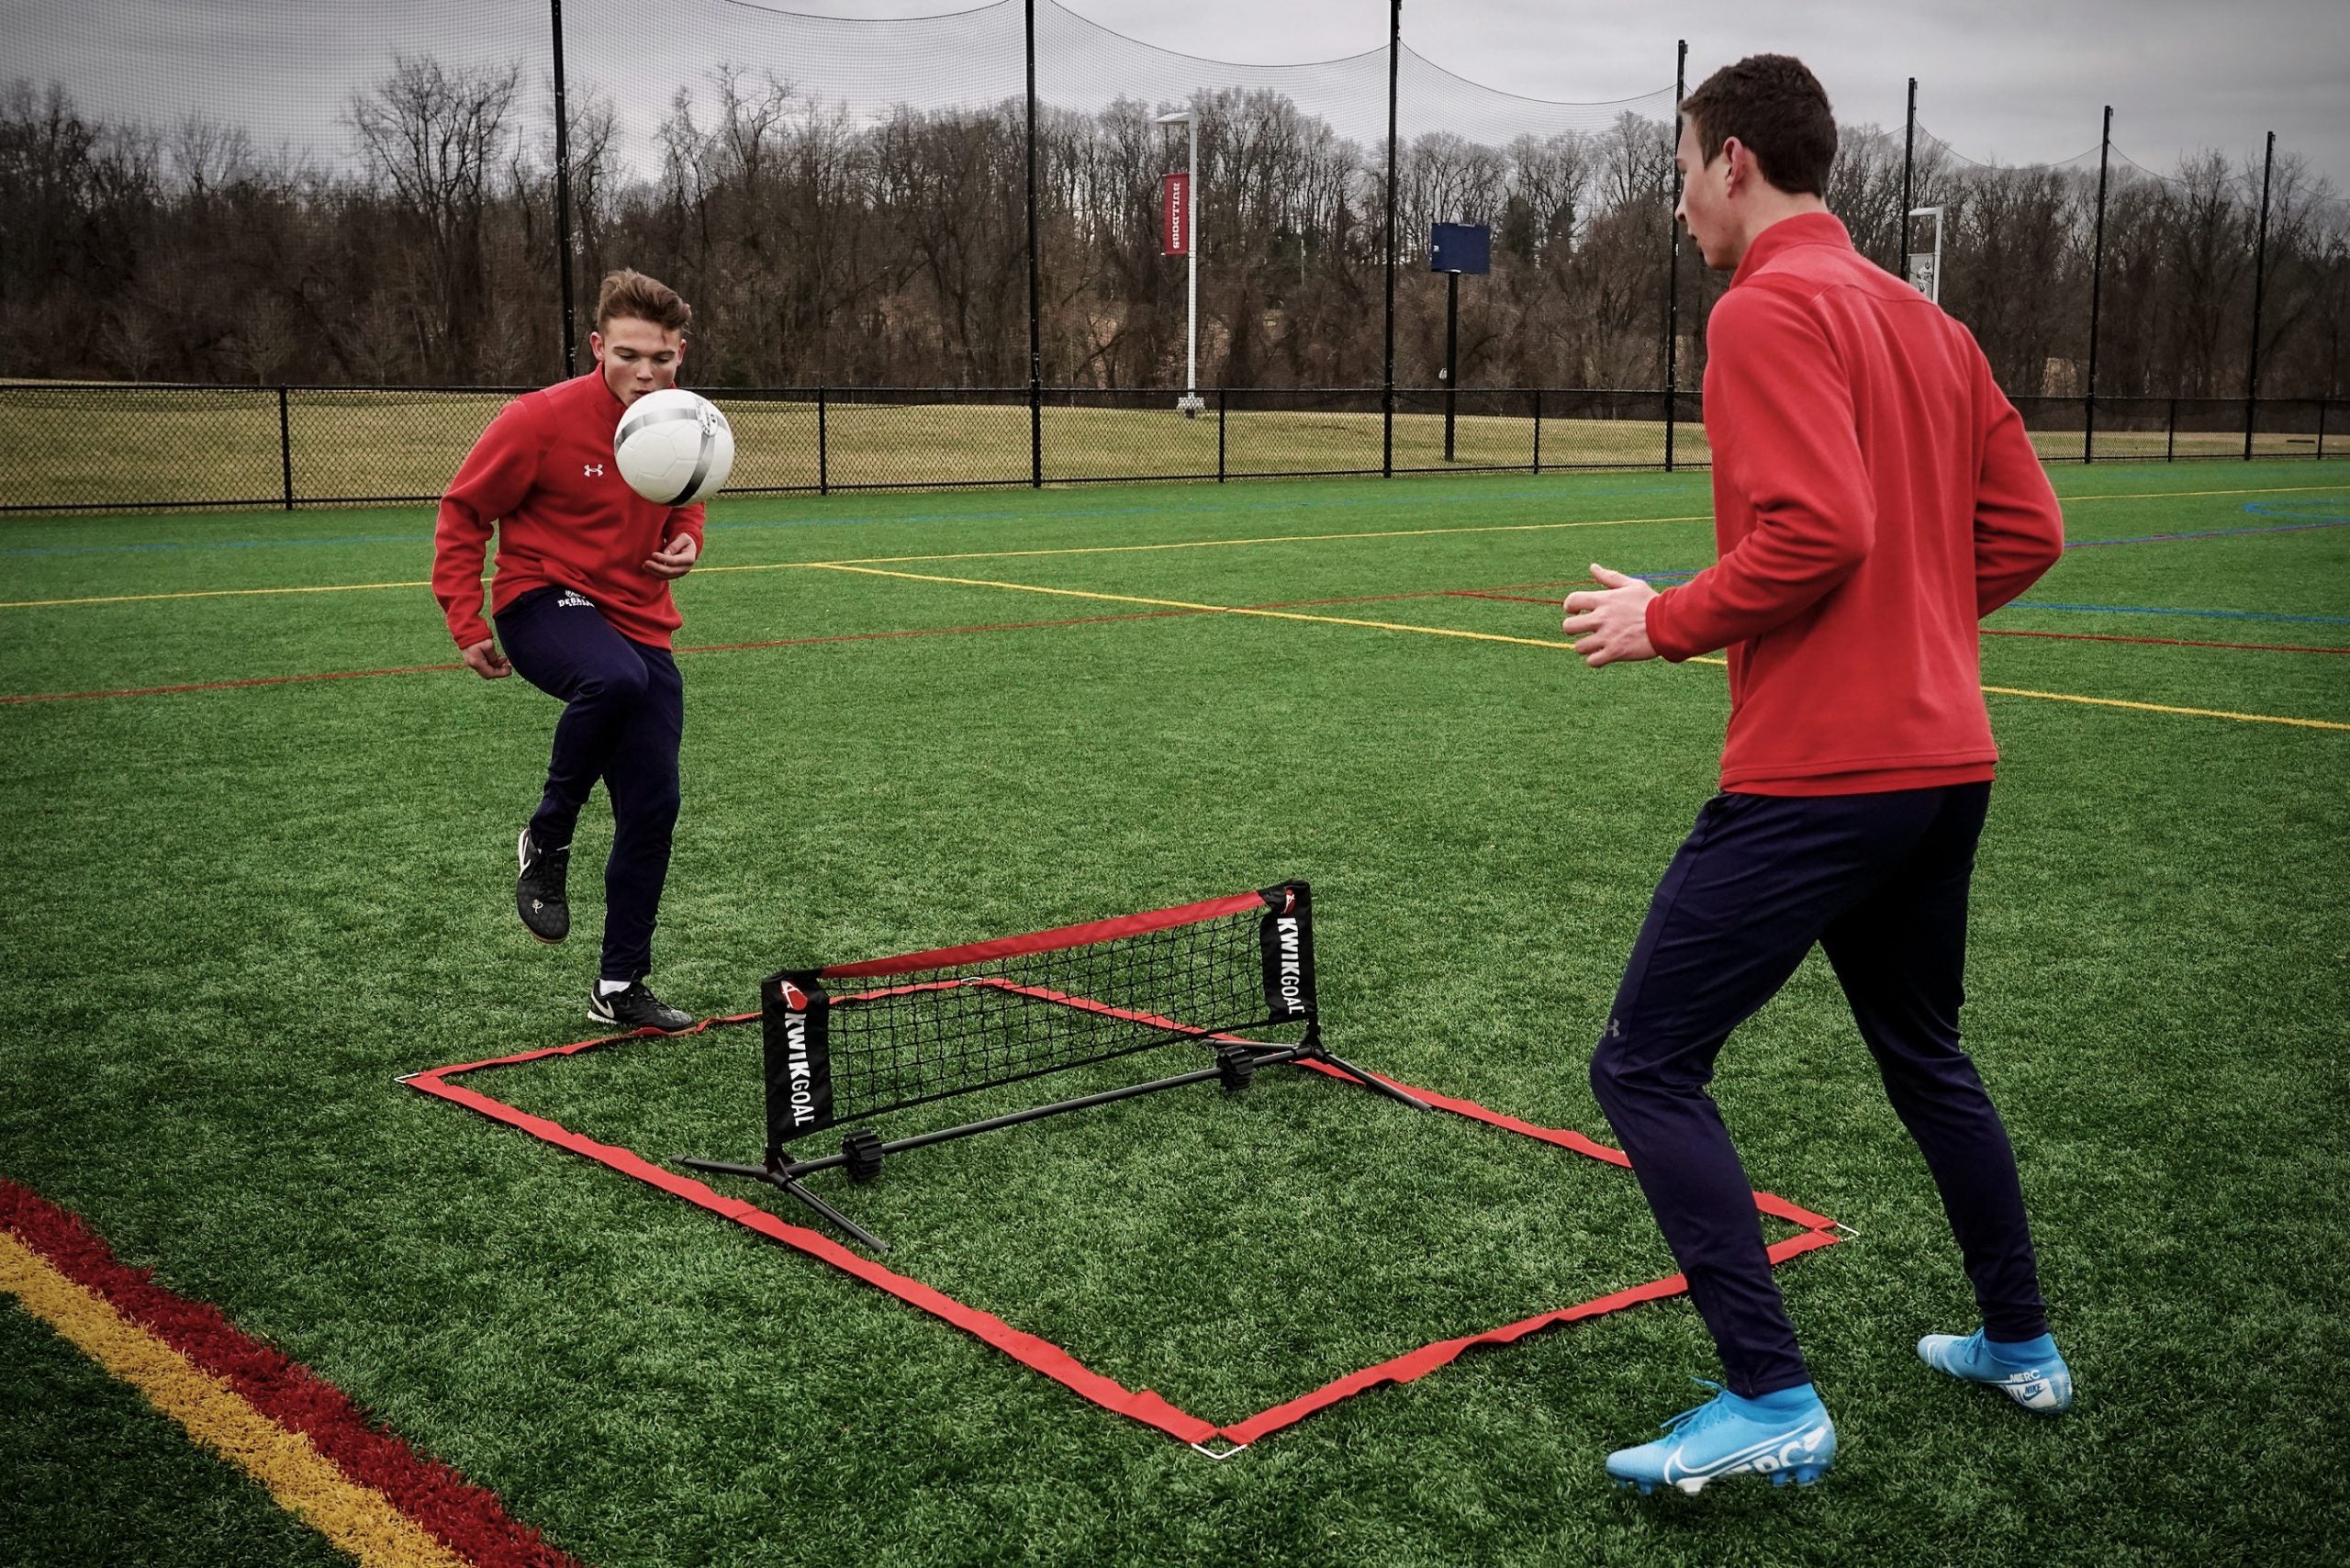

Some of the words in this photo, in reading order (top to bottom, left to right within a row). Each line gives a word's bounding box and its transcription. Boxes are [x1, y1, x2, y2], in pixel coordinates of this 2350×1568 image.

[1172, 182, 1181, 249] BULLDOGS
[1277, 918, 1305, 1014] KWIKGOAL
[784, 1013, 815, 1127] KWIKGOAL
[2025, 1383, 2041, 1394] NIKE
